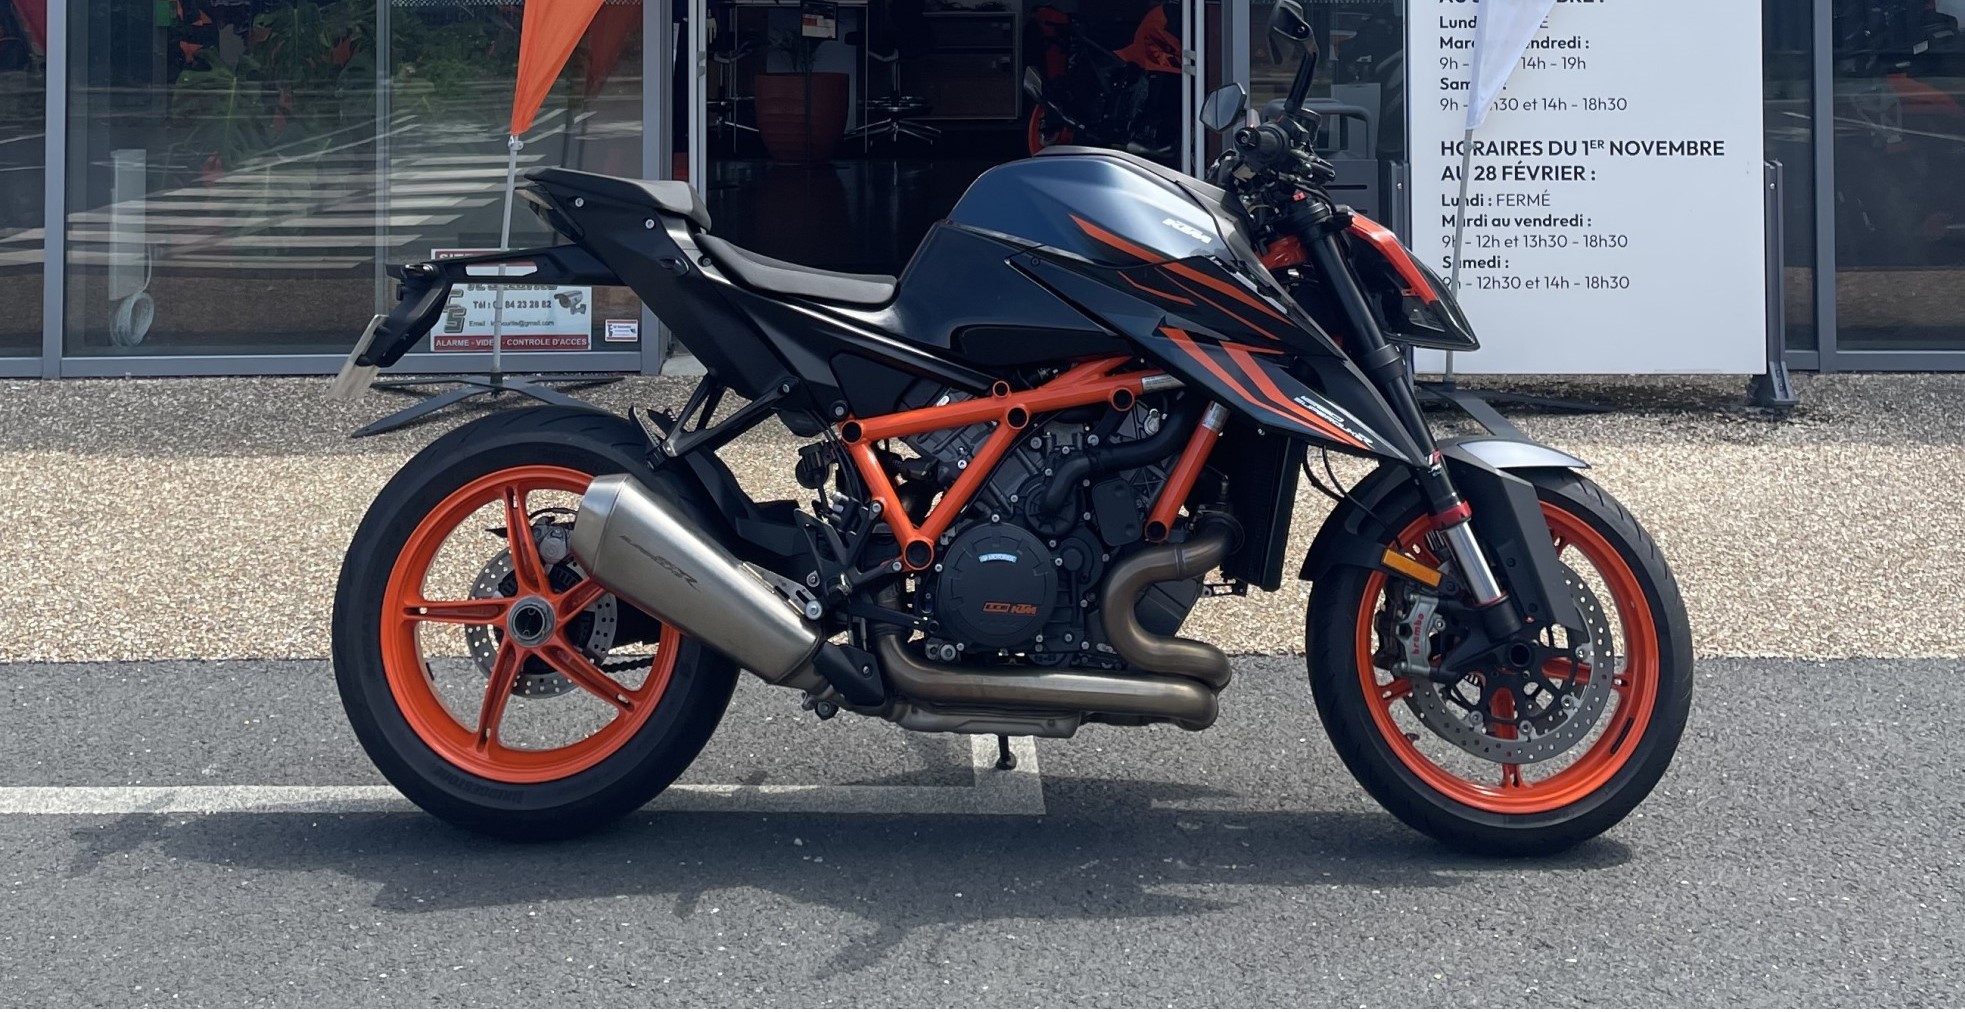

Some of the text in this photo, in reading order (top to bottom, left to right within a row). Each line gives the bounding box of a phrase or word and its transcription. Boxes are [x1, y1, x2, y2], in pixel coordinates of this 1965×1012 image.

[1439, 15, 1477, 29] Lund
[1439, 36, 1590, 49] Mar ndredi :
[1439, 57, 1458, 70] 9h
[1520, 57, 1546, 70] 14h
[1561, 57, 1586, 70] 19h
[1440, 98, 1458, 111] 9h
[1522, 98, 1538, 111] et
[1541, 98, 1567, 111] 14h
[1582, 98, 1628, 111] 18h30
[1441, 140, 1543, 156] HORAIRES
[1548, 140, 1578, 156] DU
[1609, 140, 1725, 156] NOVEMBRE
[1474, 165, 1497, 181] 28
[1502, 160, 1586, 181] FÉVRIER
[1591, 169, 1596, 181] :
[1488, 197, 1492, 207] :
[1496, 189, 1551, 207] FERMÉ
[1491, 217, 1511, 228] au
[1514, 214, 1583, 228] vendredi
[1587, 217, 1592, 228] :
[1162, 218, 1212, 244] KTM
[1475, 235, 1500, 248] 12h
[1504, 235, 1520, 248] et
[1523, 235, 1568, 248] 13h30
[1582, 235, 1628, 248] 18h30
[1504, 259, 1509, 269] :
[1476, 276, 1521, 289] 12h30
[1525, 276, 1541, 289] et
[1544, 276, 1569, 289] 14h
[1584, 276, 1630, 289] 18h30
[504, 301, 515, 309] 84
[517, 301, 528, 309] 23
[436, 339, 470, 347] ALARME
[506, 338, 550, 346] CONTROLE
[552, 338, 587, 346] D'ACCES
[1010, 603, 1038, 616] KTM
[1412, 613, 1425, 655] brembo
